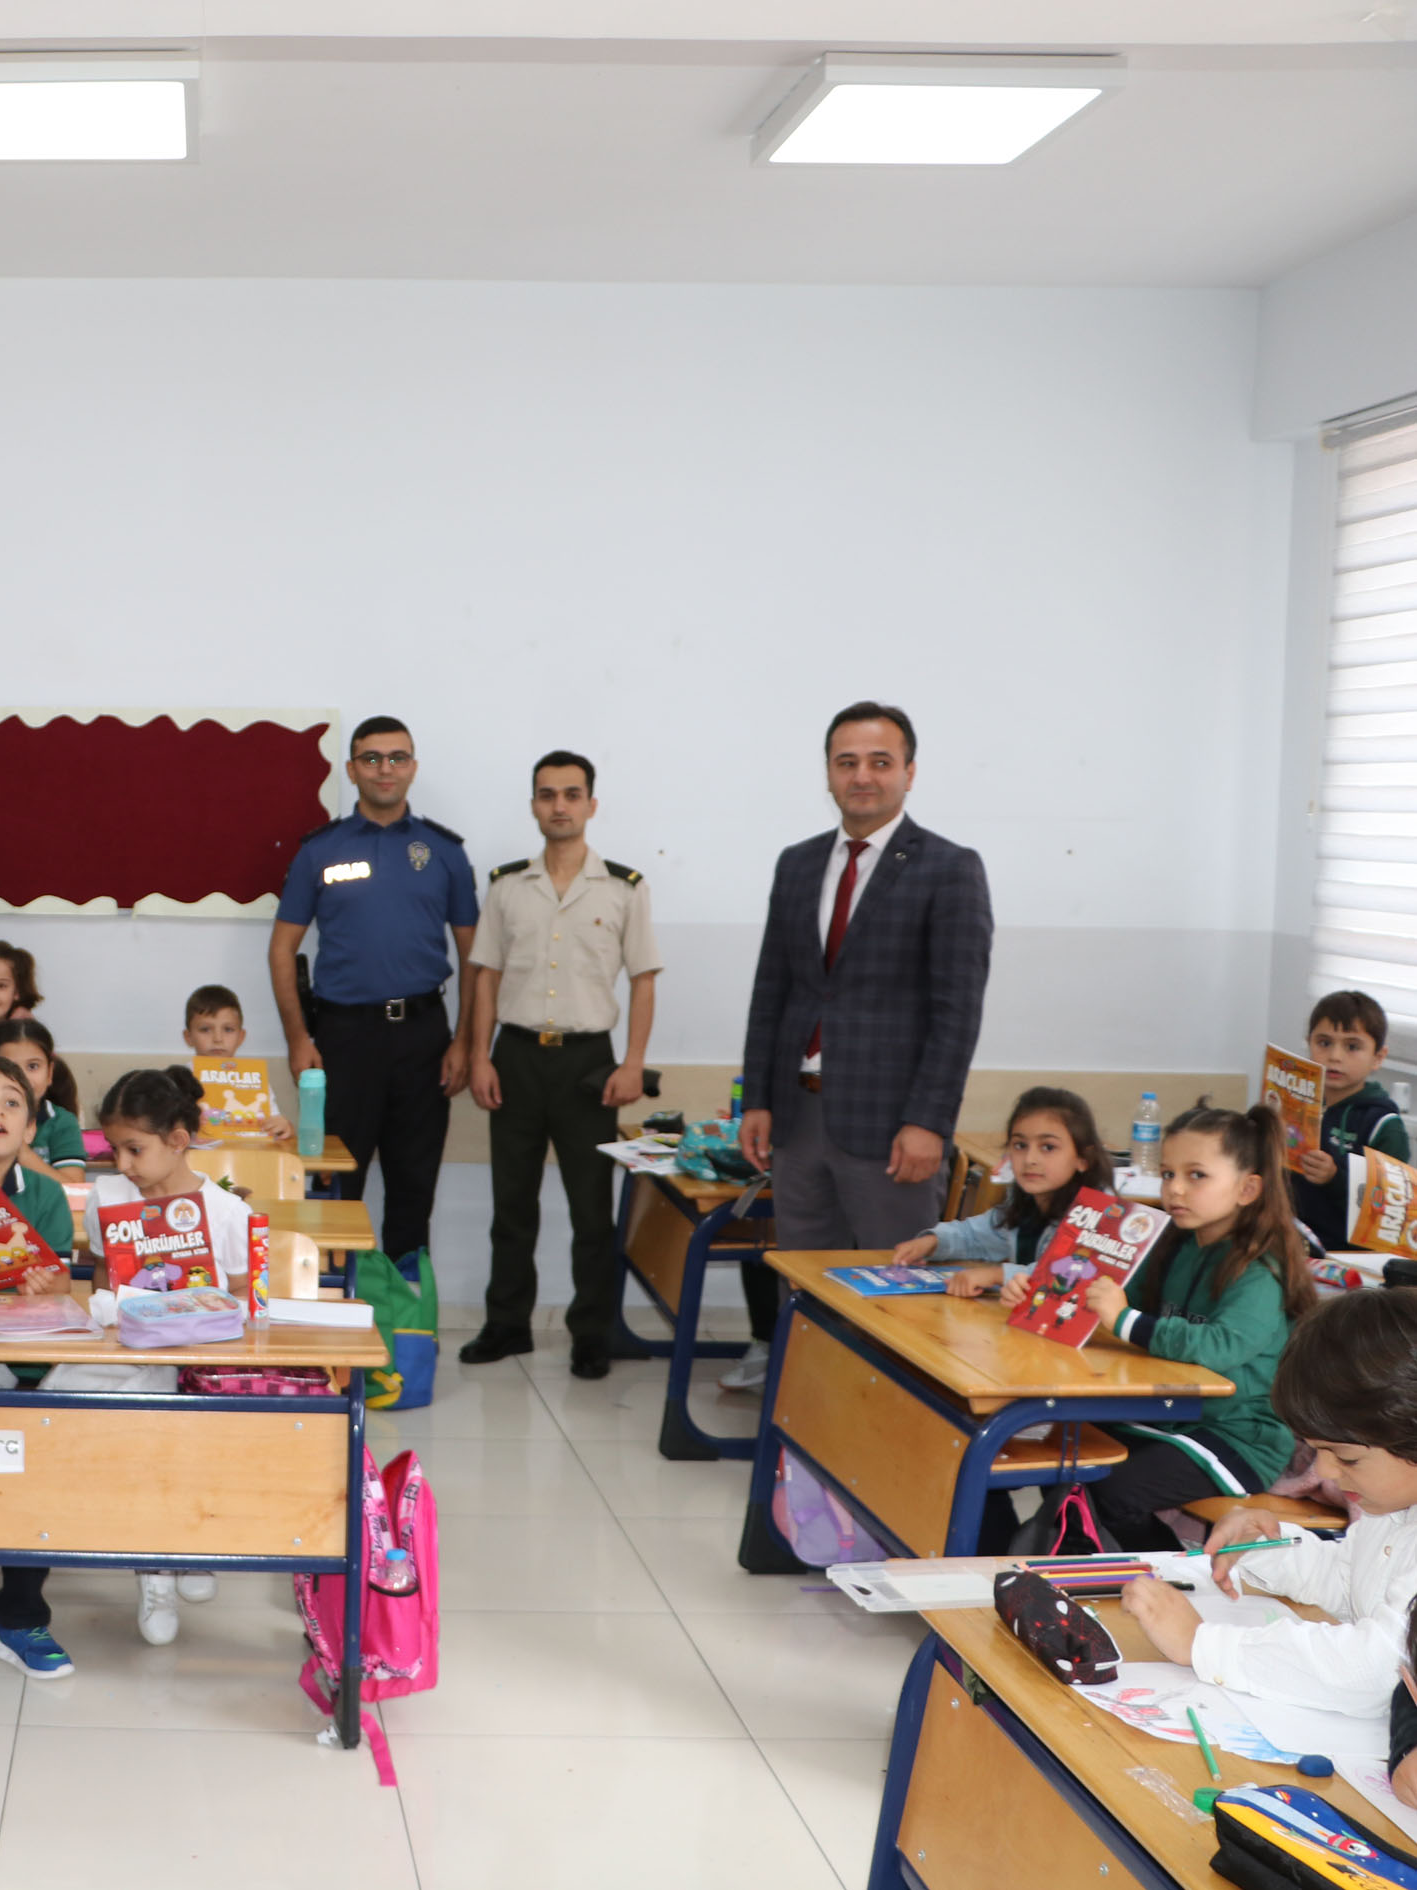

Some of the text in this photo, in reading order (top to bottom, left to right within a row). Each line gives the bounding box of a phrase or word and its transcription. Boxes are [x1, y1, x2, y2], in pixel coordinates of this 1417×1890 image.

[200, 1069, 261, 1087] ARAÇLAR
[1267, 1063, 1316, 1098] ARAÇLAR
[1066, 1205, 1103, 1231] SON
[105, 1219, 146, 1245] SON
[134, 1230, 206, 1257] DÜRÜMLER
[1075, 1228, 1138, 1261] DÜRÜMLER
